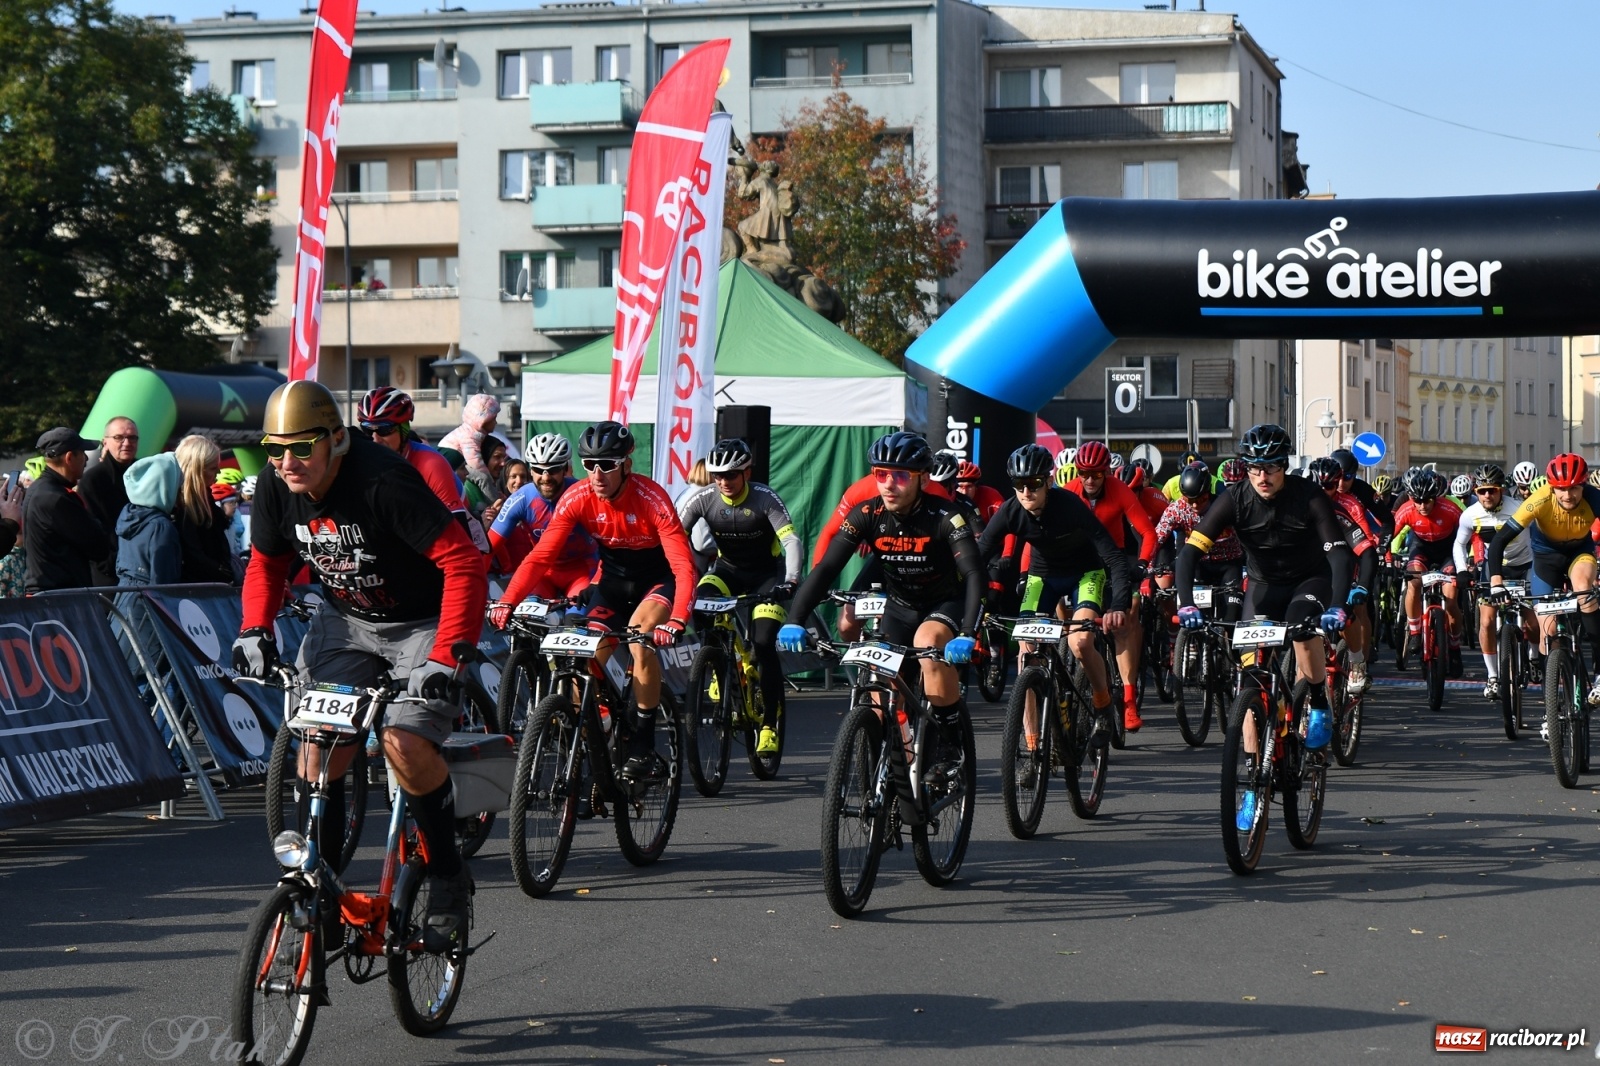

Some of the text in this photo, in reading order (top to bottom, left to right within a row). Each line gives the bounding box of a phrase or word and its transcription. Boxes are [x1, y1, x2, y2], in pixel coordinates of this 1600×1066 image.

[1197, 246, 1502, 299] bike atelier
[1112, 373, 1141, 381] SEKTOR
[1114, 382, 1138, 414] 0
[874, 536, 931, 553] CST
[519, 605, 540, 613] 177
[1021, 625, 1054, 635] 2202
[1241, 629, 1276, 639] 2635
[552, 635, 589, 647] 1626
[854, 649, 893, 663] 1407
[302, 696, 355, 718] 1184
